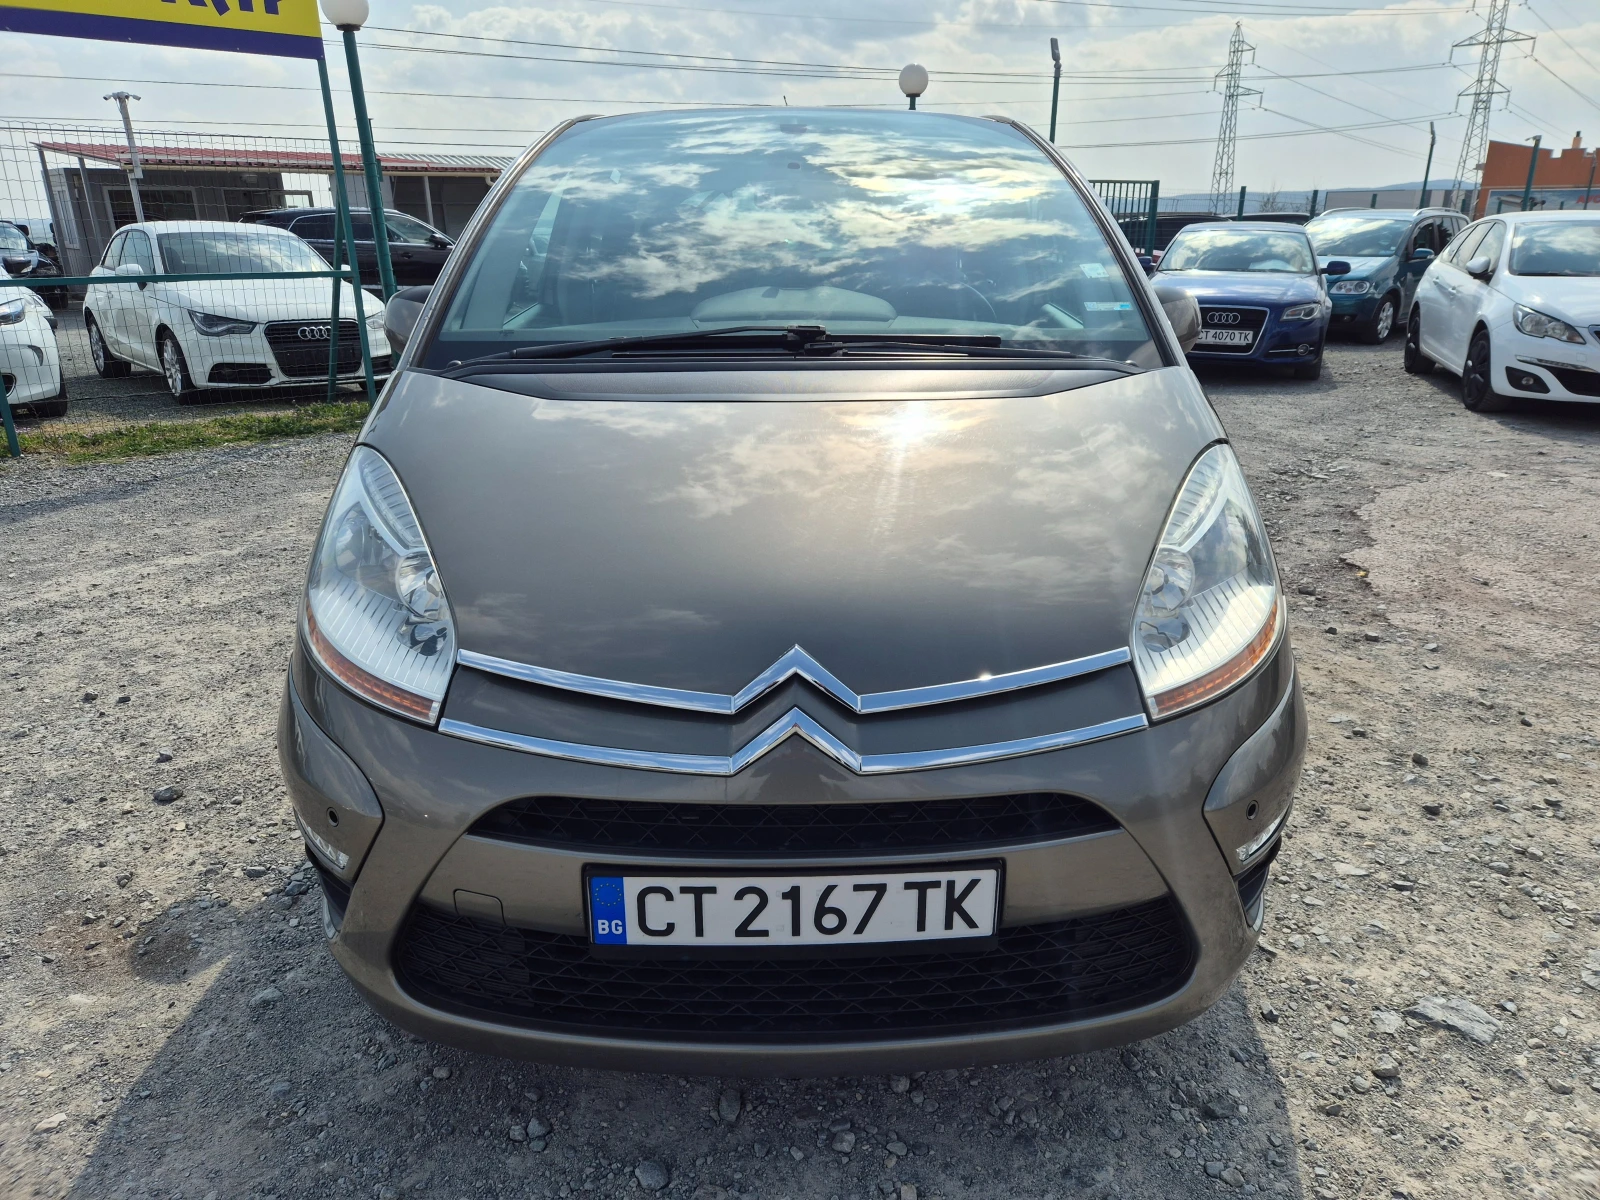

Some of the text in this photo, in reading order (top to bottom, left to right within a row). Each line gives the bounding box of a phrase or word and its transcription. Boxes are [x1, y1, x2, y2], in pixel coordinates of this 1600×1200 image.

[1212, 331, 1235, 341] 4070
[1238, 332, 1250, 342] TK
[636, 878, 982, 938] CT 2167 TK
[597, 919, 623, 935] BG
